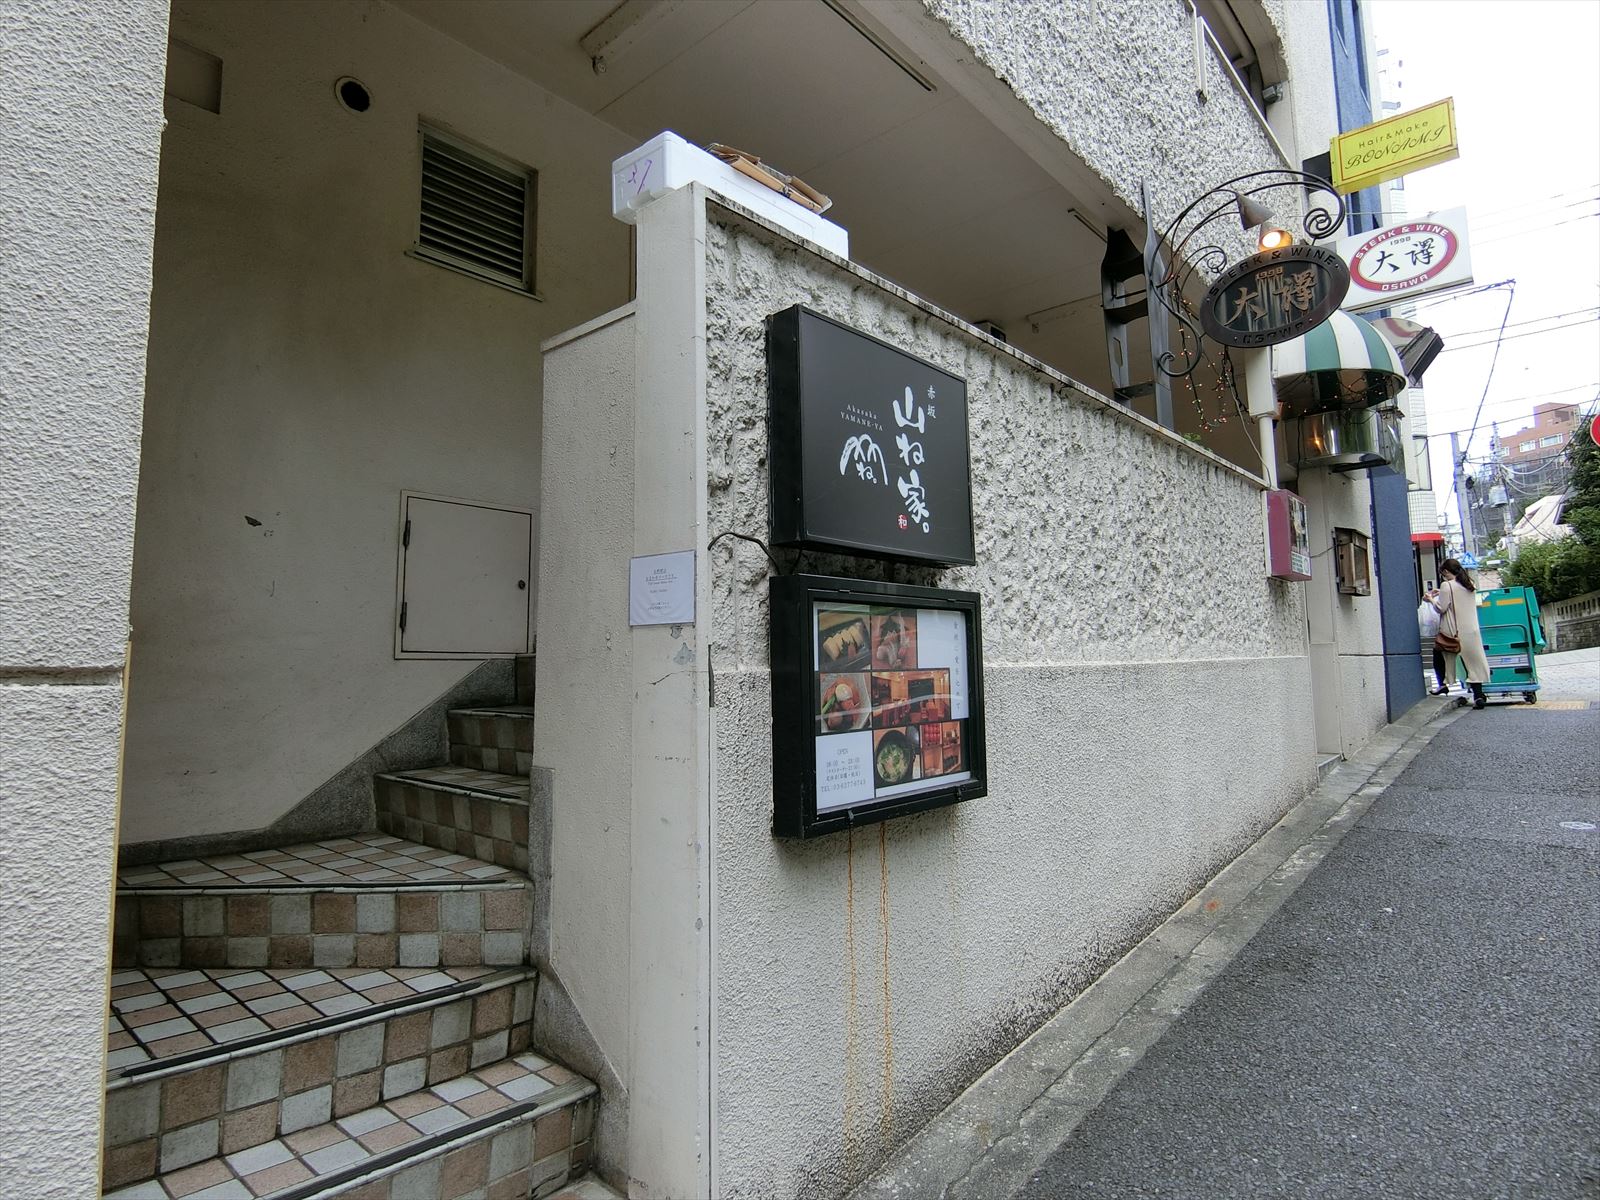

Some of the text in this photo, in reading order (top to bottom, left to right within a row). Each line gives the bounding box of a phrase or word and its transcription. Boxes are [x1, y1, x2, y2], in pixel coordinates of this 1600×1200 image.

[1344, 124, 1447, 170] BONAMI
[1401, 226, 1410, 234] &
[1415, 223, 1449, 237] WINE
[1389, 236, 1412, 246] 1998
[1271, 250, 1282, 259] &
[1291, 247, 1335, 266] WINE
[1380, 273, 1429, 292] OSAWA
[840, 411, 884, 432] YAMANE-YA
[846, 403, 878, 421] Akasaka
